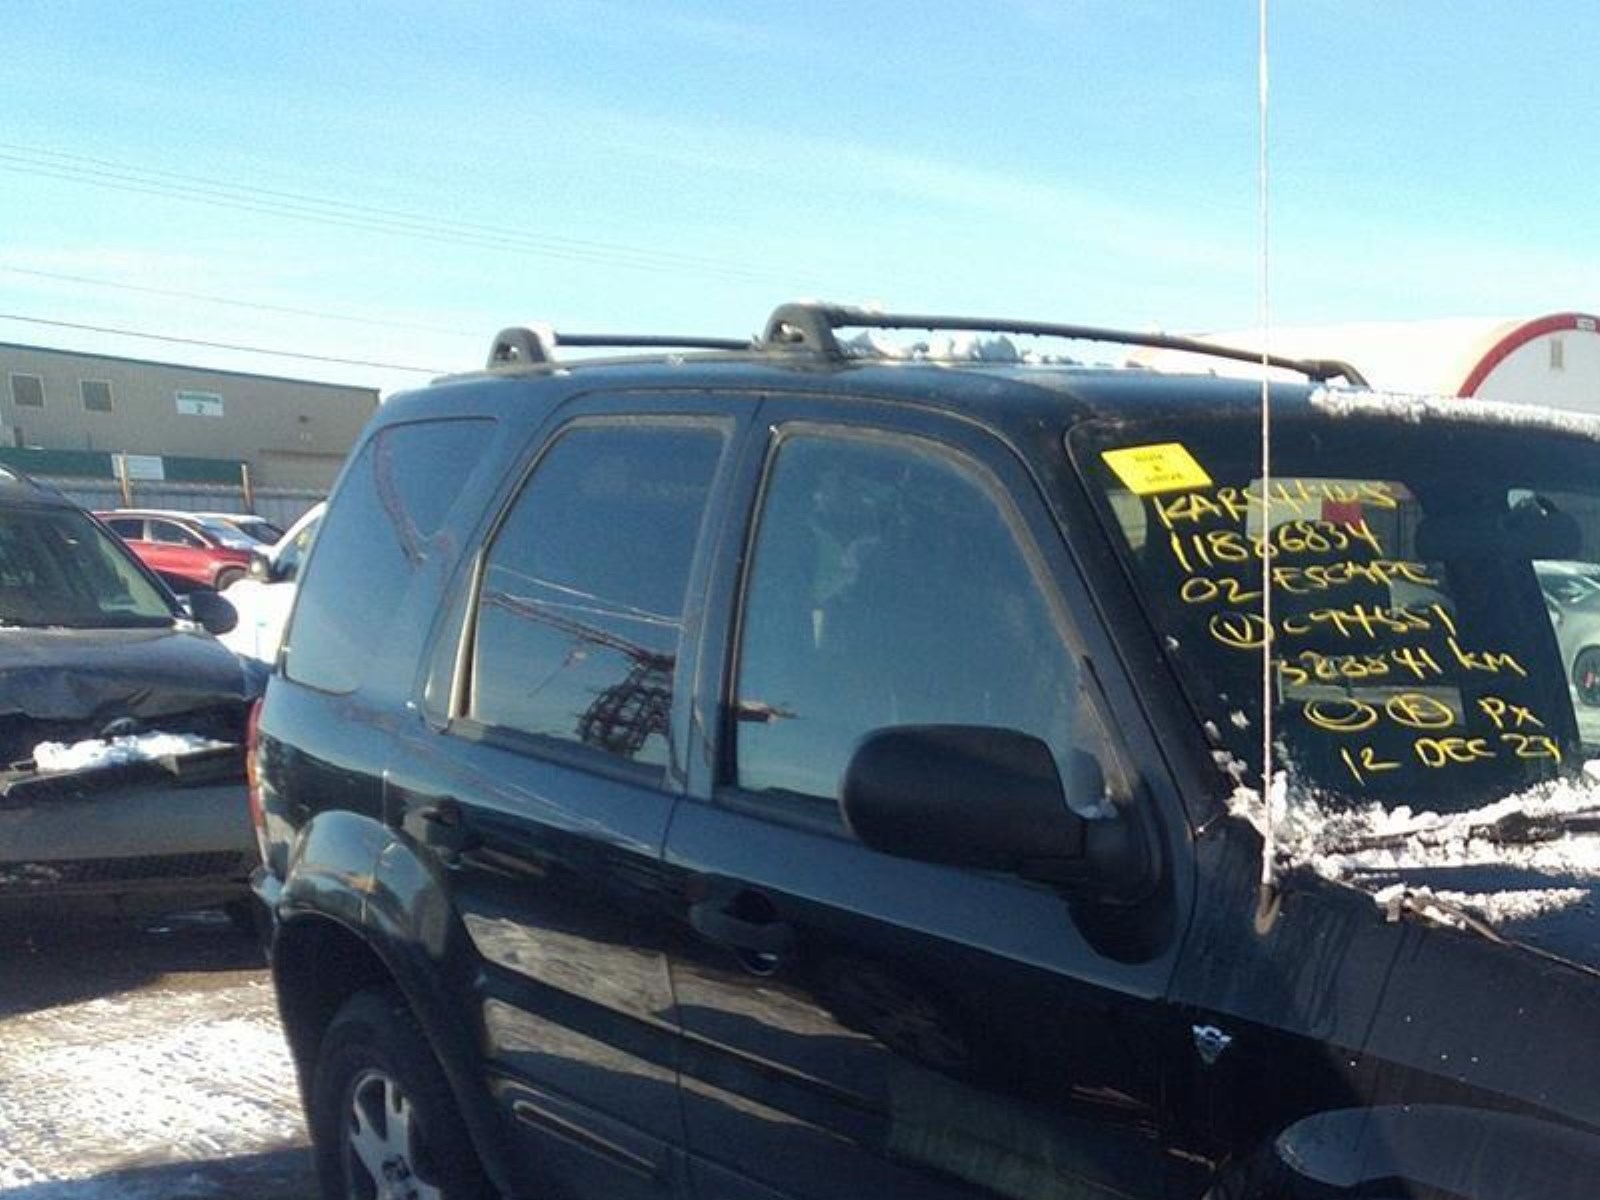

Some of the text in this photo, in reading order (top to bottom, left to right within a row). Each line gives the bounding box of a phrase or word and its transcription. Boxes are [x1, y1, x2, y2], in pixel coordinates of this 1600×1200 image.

[1181, 576, 1263, 603] 02
[1341, 746, 1402, 787] 12
[1414, 737, 1497, 768] DEC
